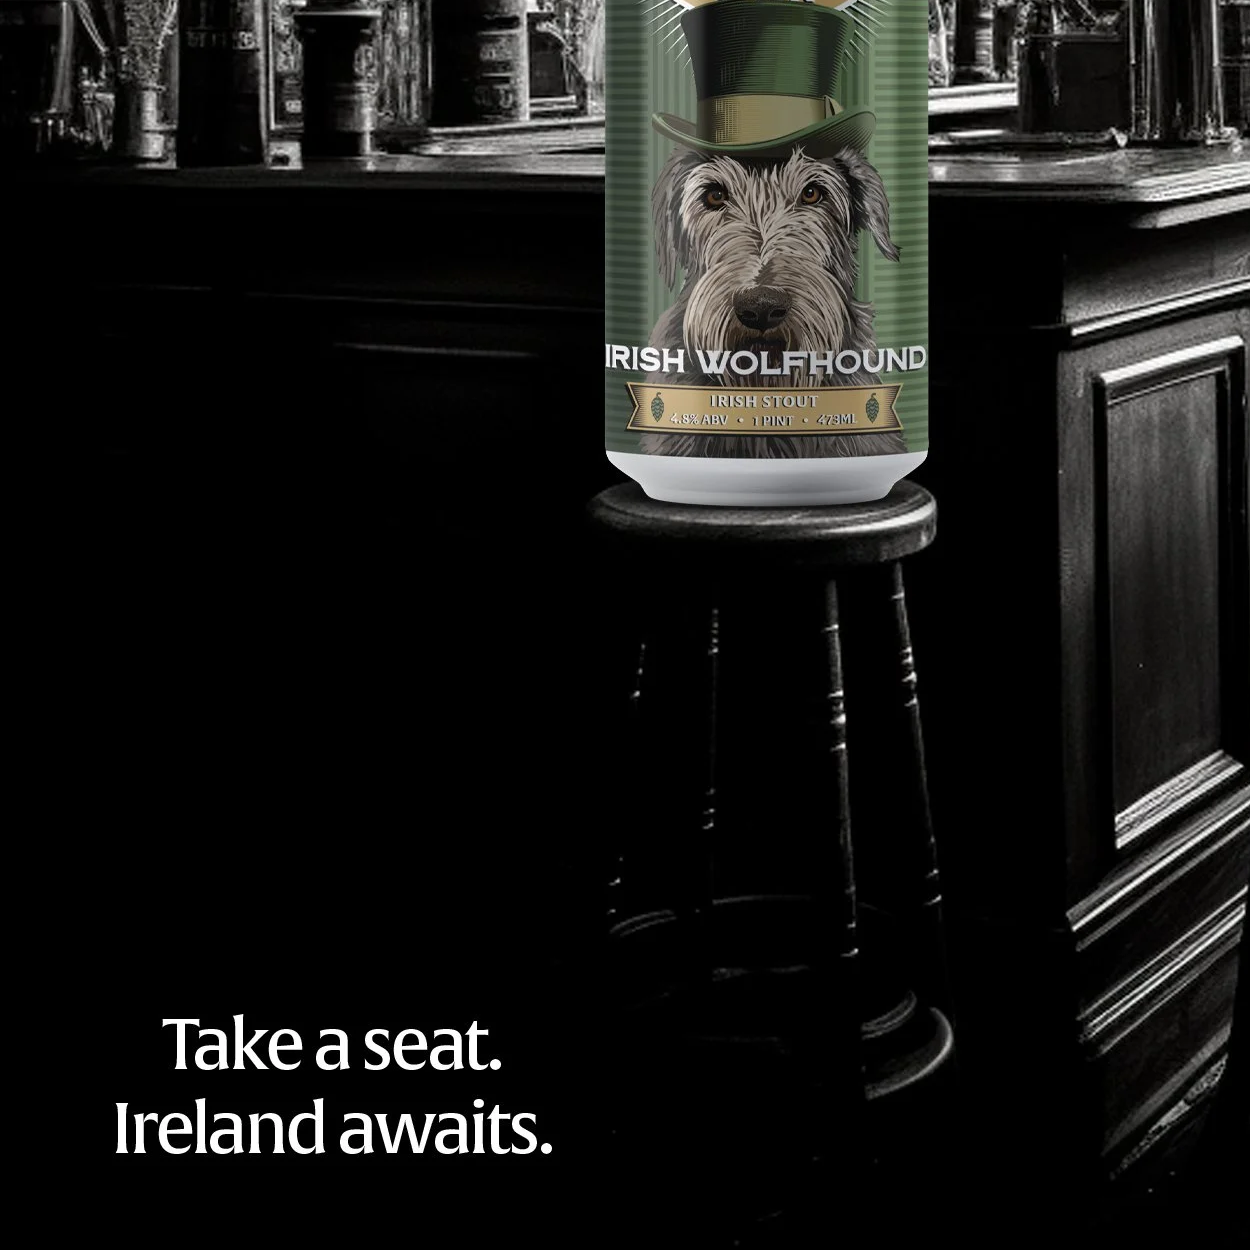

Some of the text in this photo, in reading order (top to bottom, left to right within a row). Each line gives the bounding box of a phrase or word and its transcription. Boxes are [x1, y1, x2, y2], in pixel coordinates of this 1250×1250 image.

[605, 343, 927, 376] IRISH WOLFHOUND
[710, 394, 819, 408] IRISH STOUT
[669, 413, 858, 427] 4.8% ABV 1 PINT 473ML
